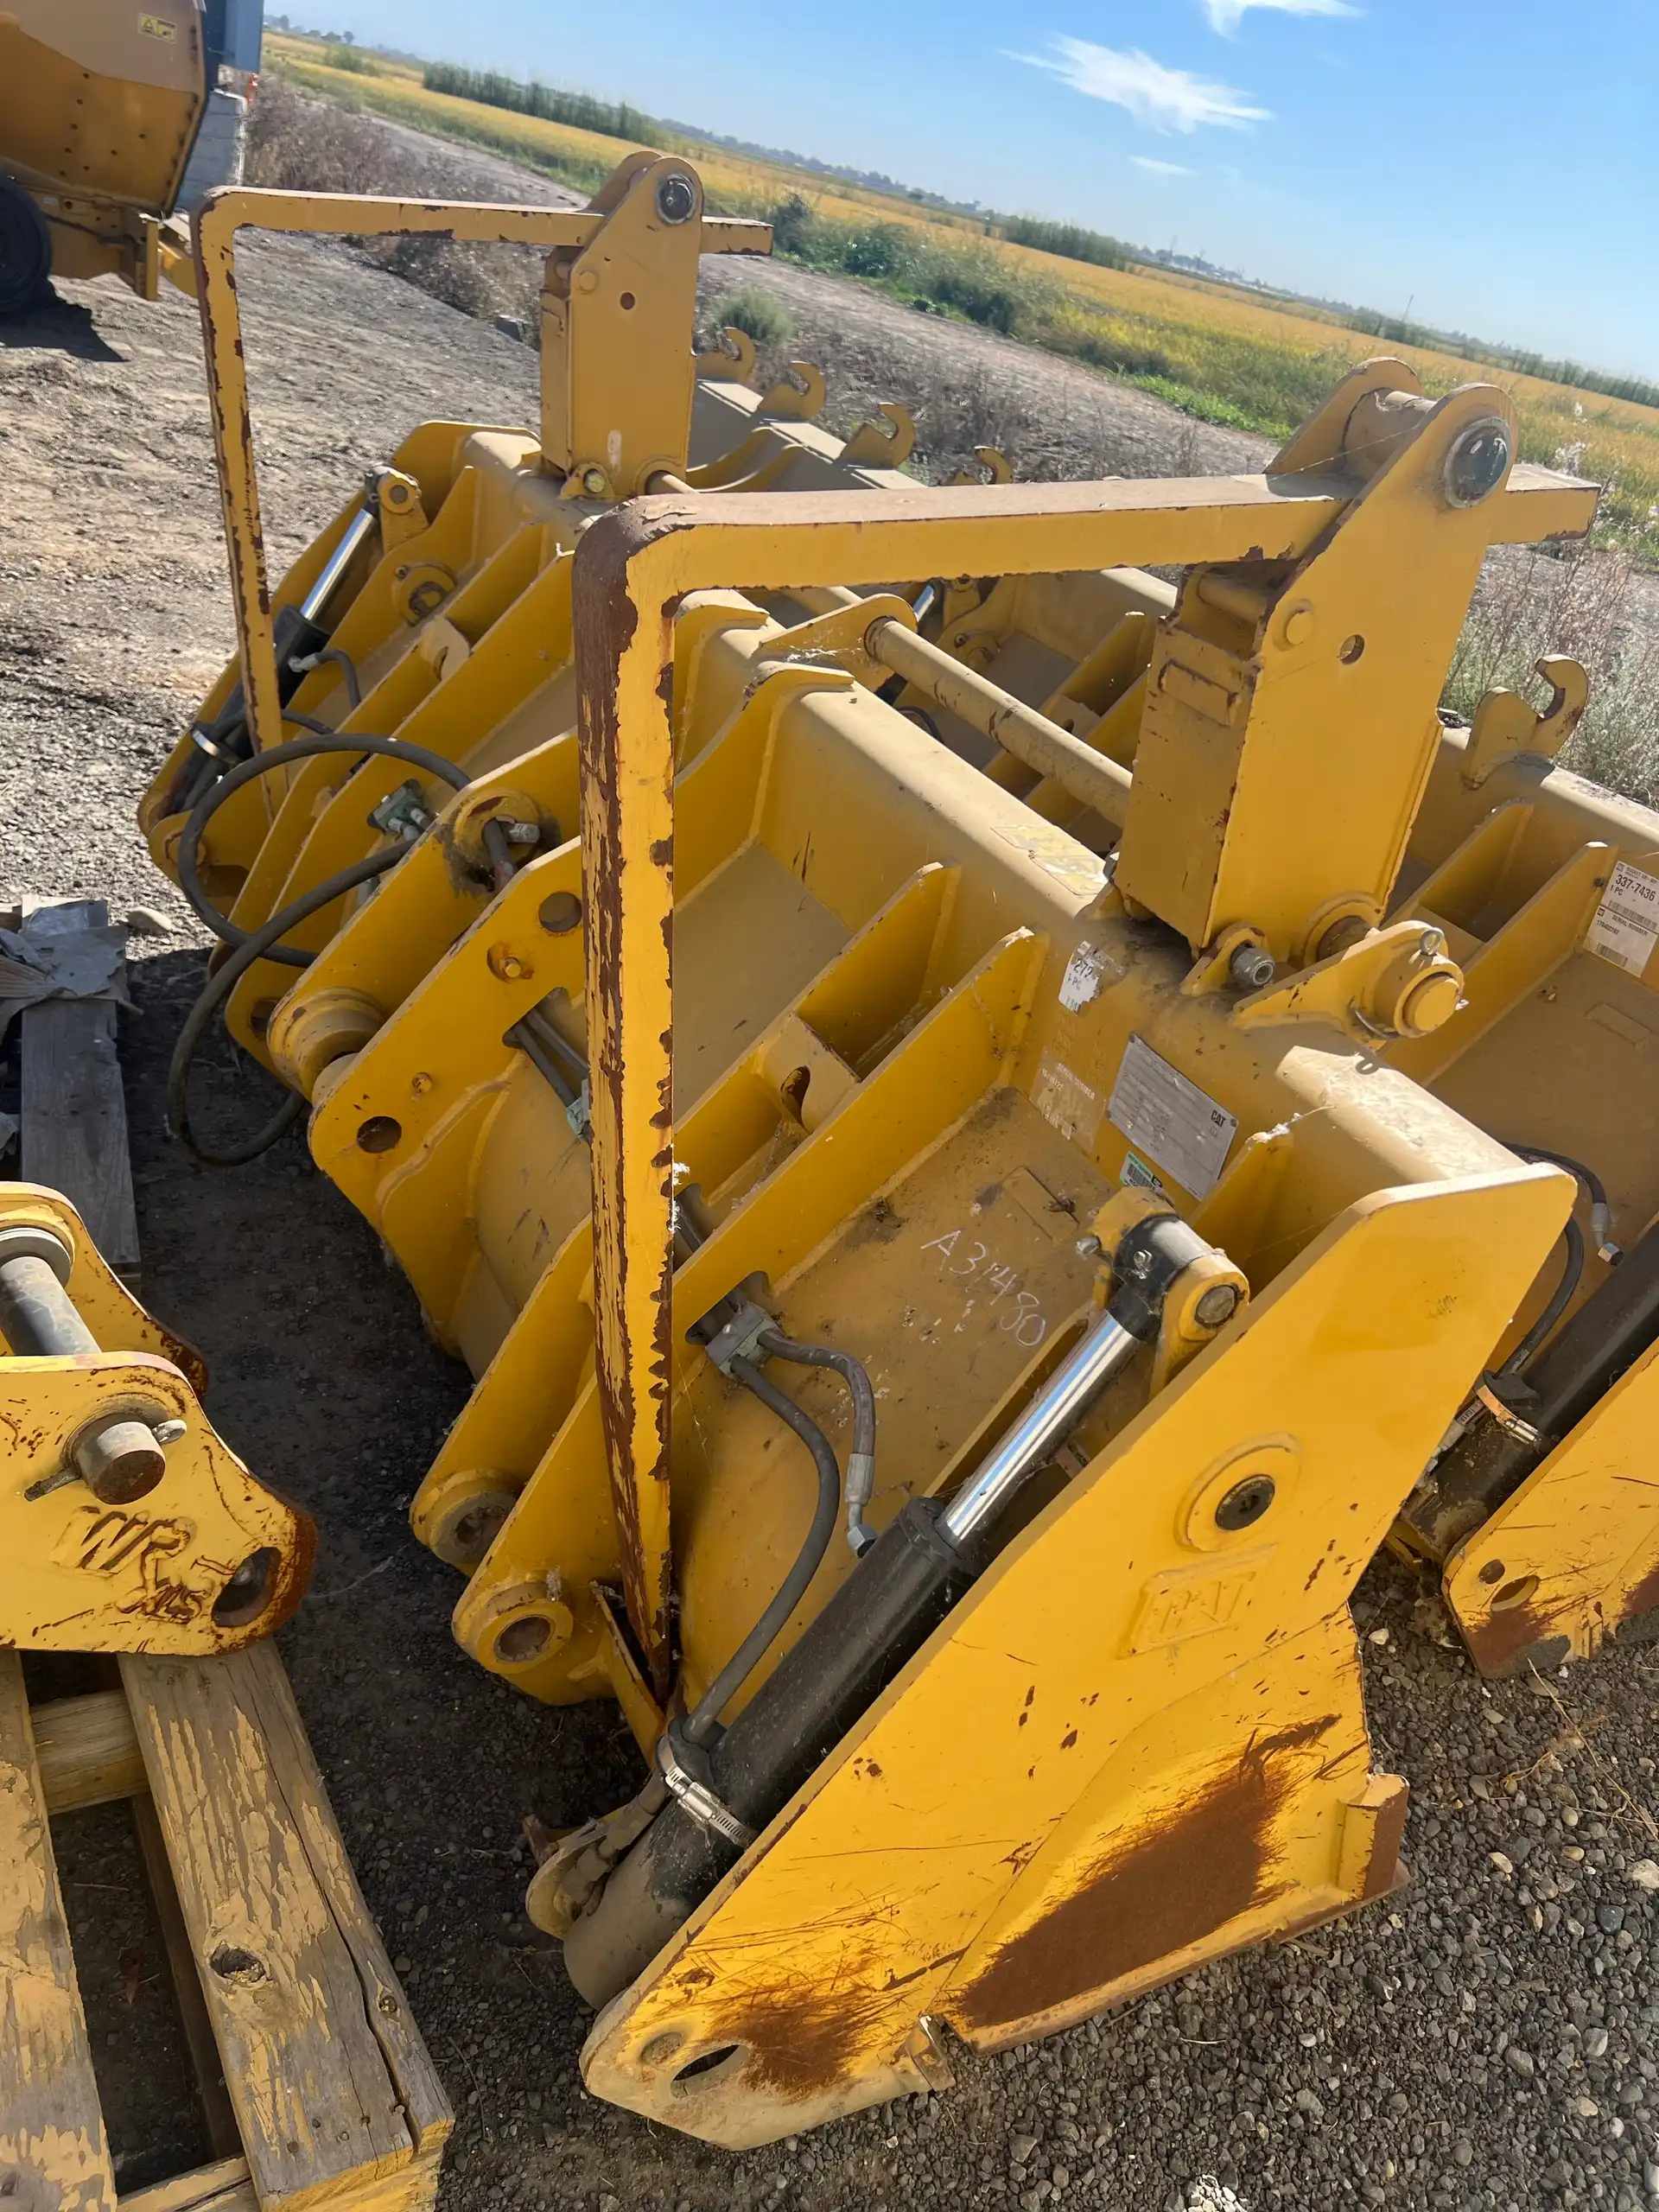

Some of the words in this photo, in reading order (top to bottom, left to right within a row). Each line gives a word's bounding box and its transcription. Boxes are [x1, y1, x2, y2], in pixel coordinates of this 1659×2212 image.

[1614, 886, 1624, 896] PC
[1615, 874, 1656, 901] 337-7436
[1211, 1109, 1227, 1128] CAT
